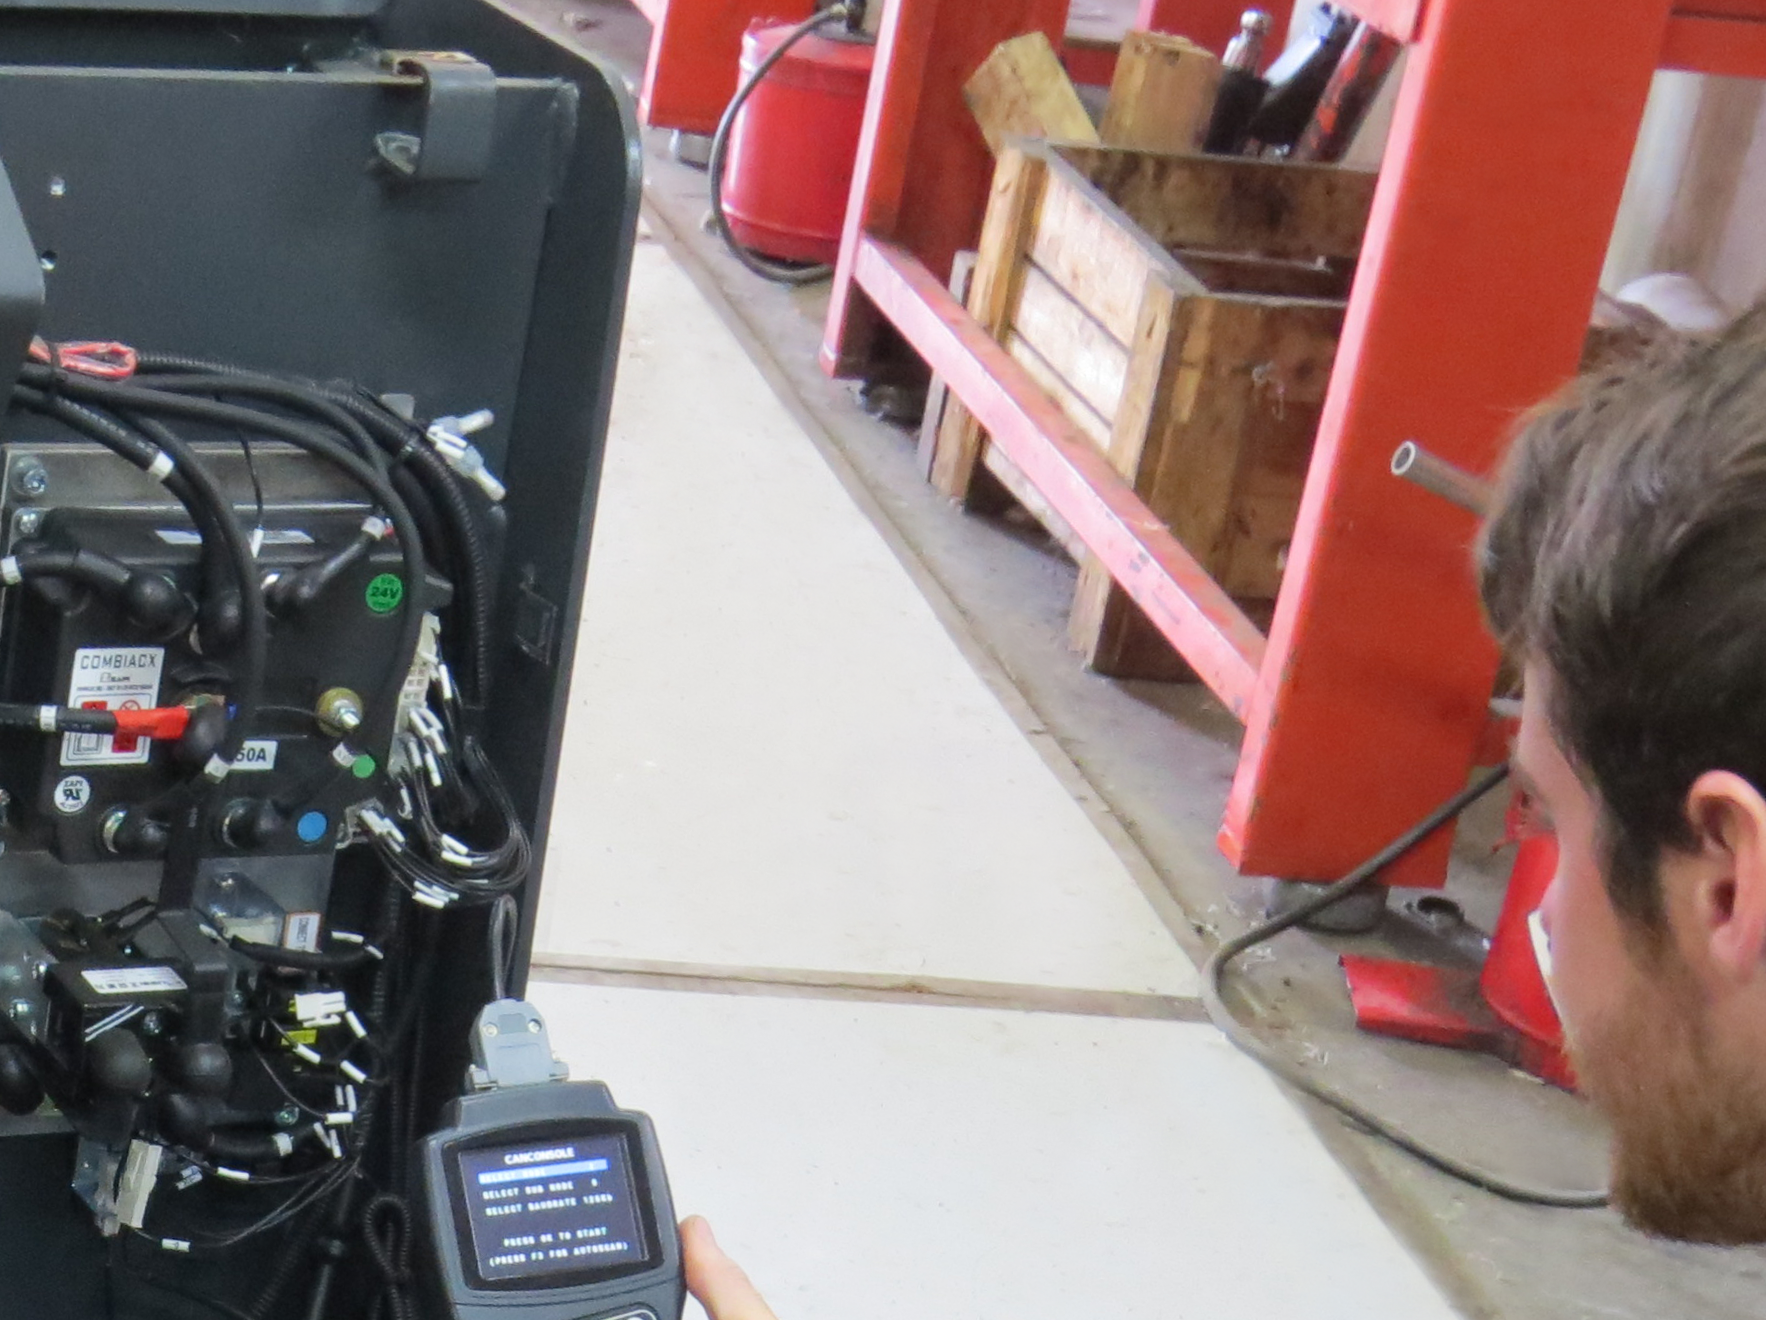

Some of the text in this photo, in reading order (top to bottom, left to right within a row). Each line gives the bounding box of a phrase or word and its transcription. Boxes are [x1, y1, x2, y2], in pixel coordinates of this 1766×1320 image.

[80, 654, 158, 669] COMBIACX
[504, 1147, 575, 1165] CANCONSOLE
[482, 1187, 519, 1200] SELECT
[485, 1203, 522, 1216] SELECT
[527, 1197, 577, 1211] BAUDRATE
[503, 1236, 535, 1247] PRESS
[558, 1231, 572, 1240] TO
[576, 1226, 607, 1239] START
[489, 1253, 526, 1267] (PRESS
[549, 1248, 568, 1258] FOR
